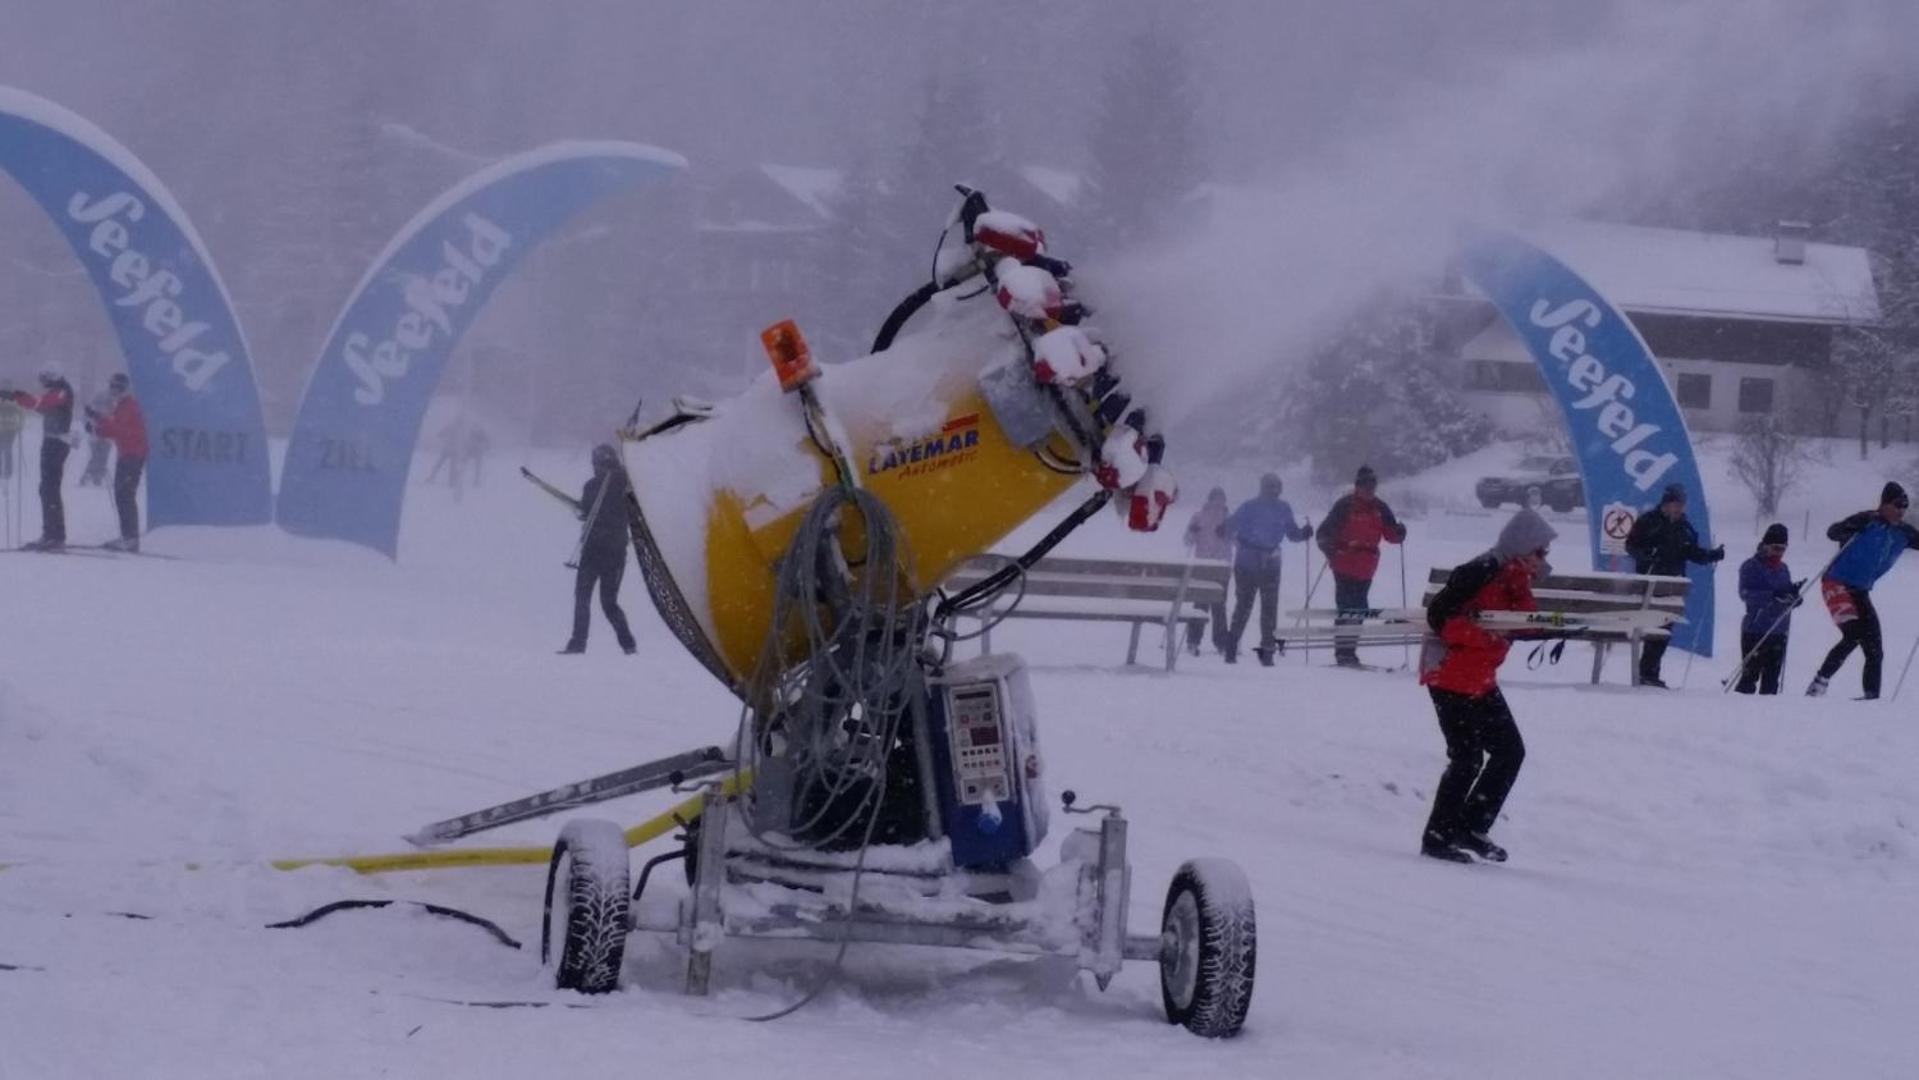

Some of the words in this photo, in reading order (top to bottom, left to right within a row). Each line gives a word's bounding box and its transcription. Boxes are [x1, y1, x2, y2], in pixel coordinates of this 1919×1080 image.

[68, 191, 230, 391] Seefeld
[343, 211, 512, 404] Seefeld
[161, 428, 248, 465] START
[1530, 299, 1678, 491] Seefeld
